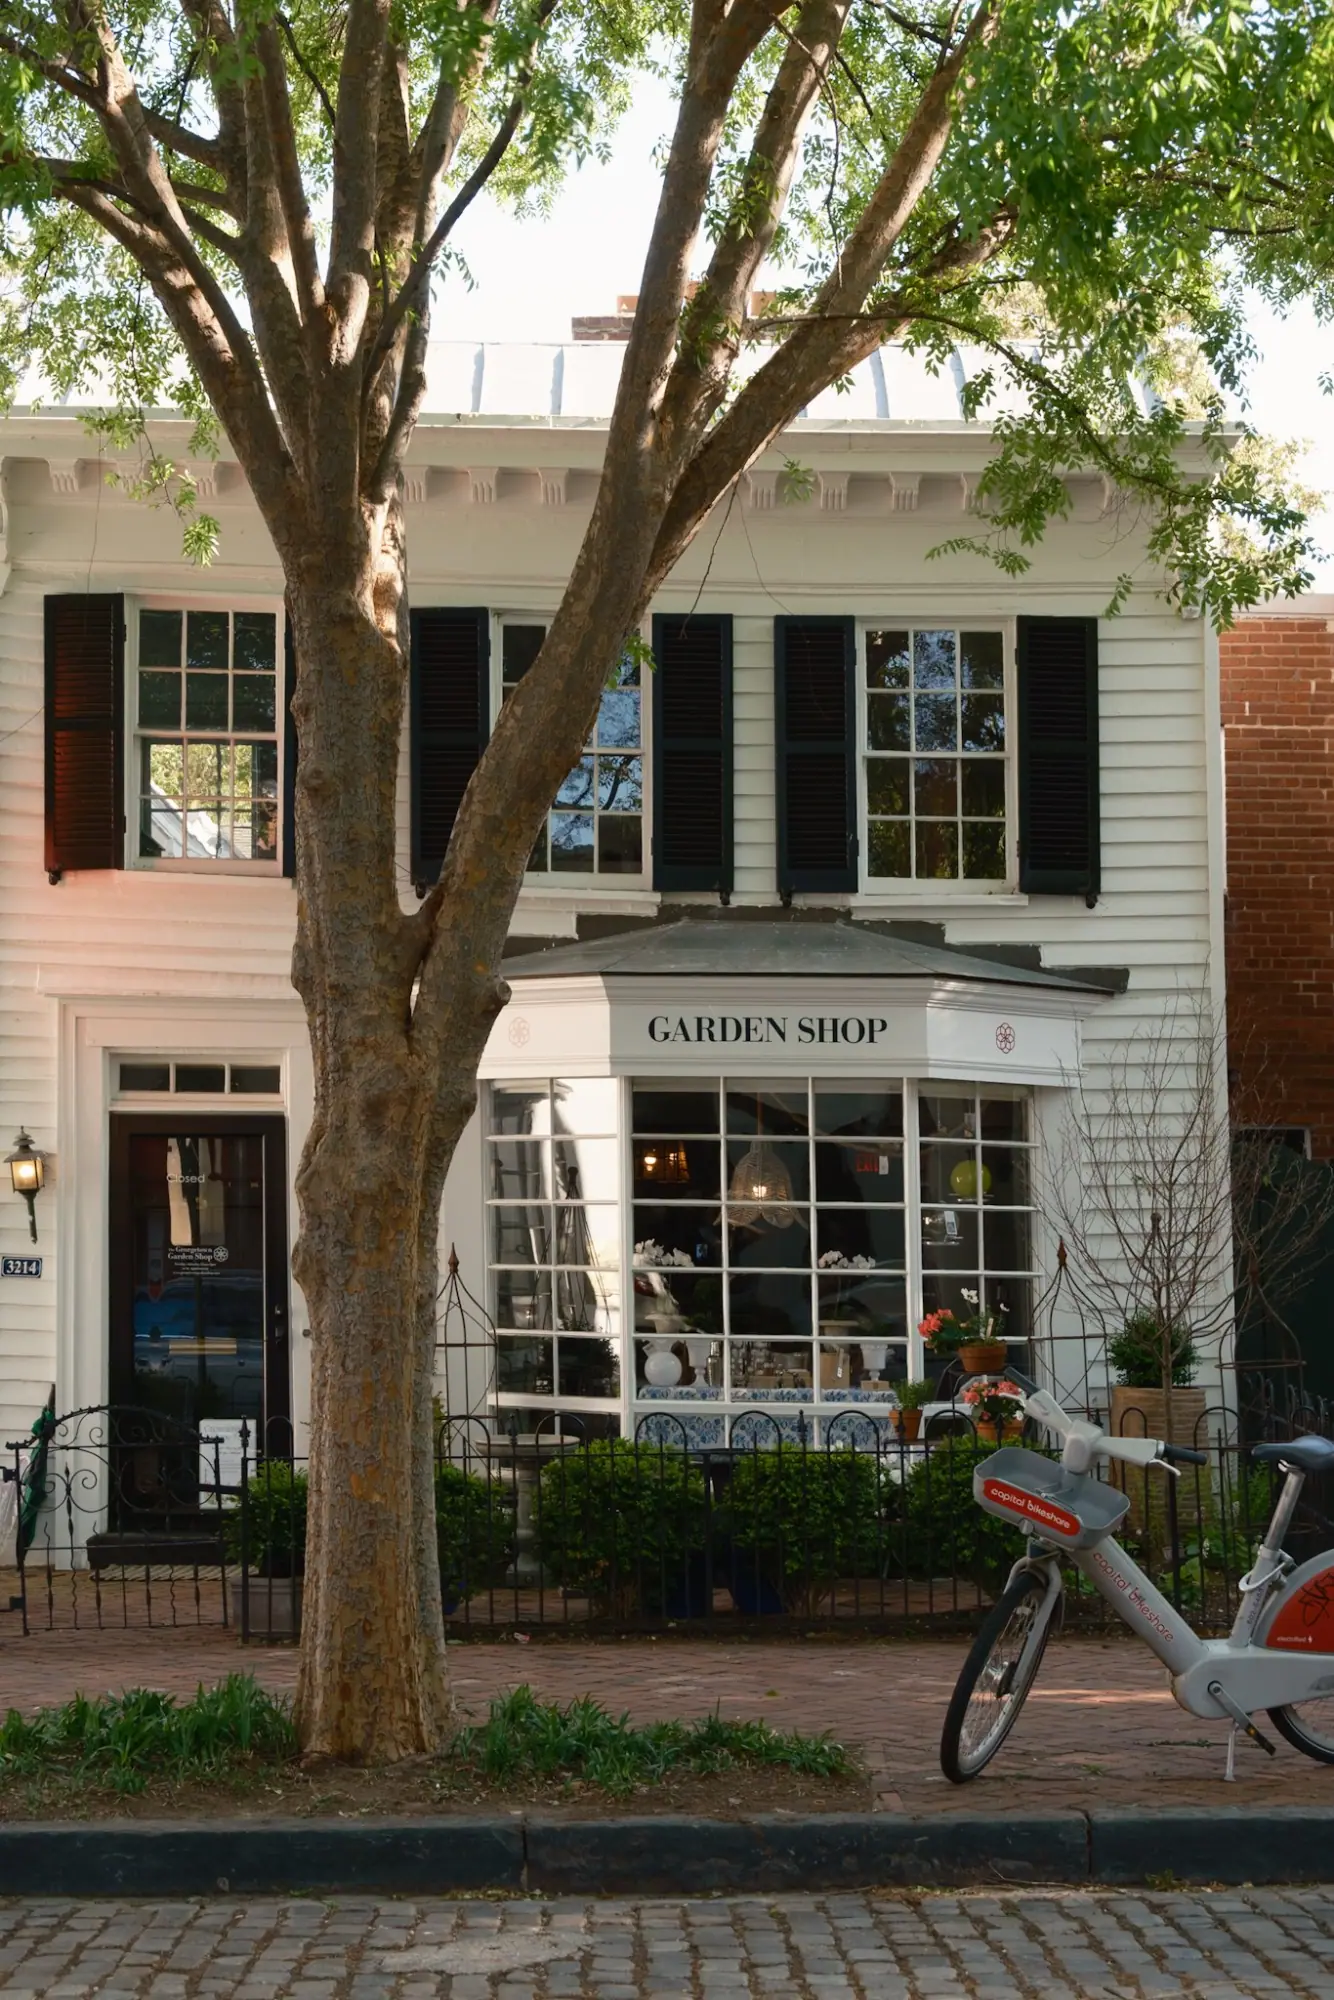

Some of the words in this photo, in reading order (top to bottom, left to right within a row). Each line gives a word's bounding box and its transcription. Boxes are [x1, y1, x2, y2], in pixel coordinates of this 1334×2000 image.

[648, 1016, 788, 1042] GARDEN
[798, 1016, 888, 1044] SHOP
[855, 1153, 880, 1173] EXI
[166, 1173, 206, 1183] Closed
[6, 1260, 37, 1274] 3214
[167, 1252, 194, 1260] Garden
[194, 1252, 213, 1262] Shop
[990, 1488, 1026, 1507] capital
[1027, 1500, 1071, 1529] bikeshare
[1093, 1552, 1131, 1592] capital
[1128, 1586, 1174, 1642] bikeshare
